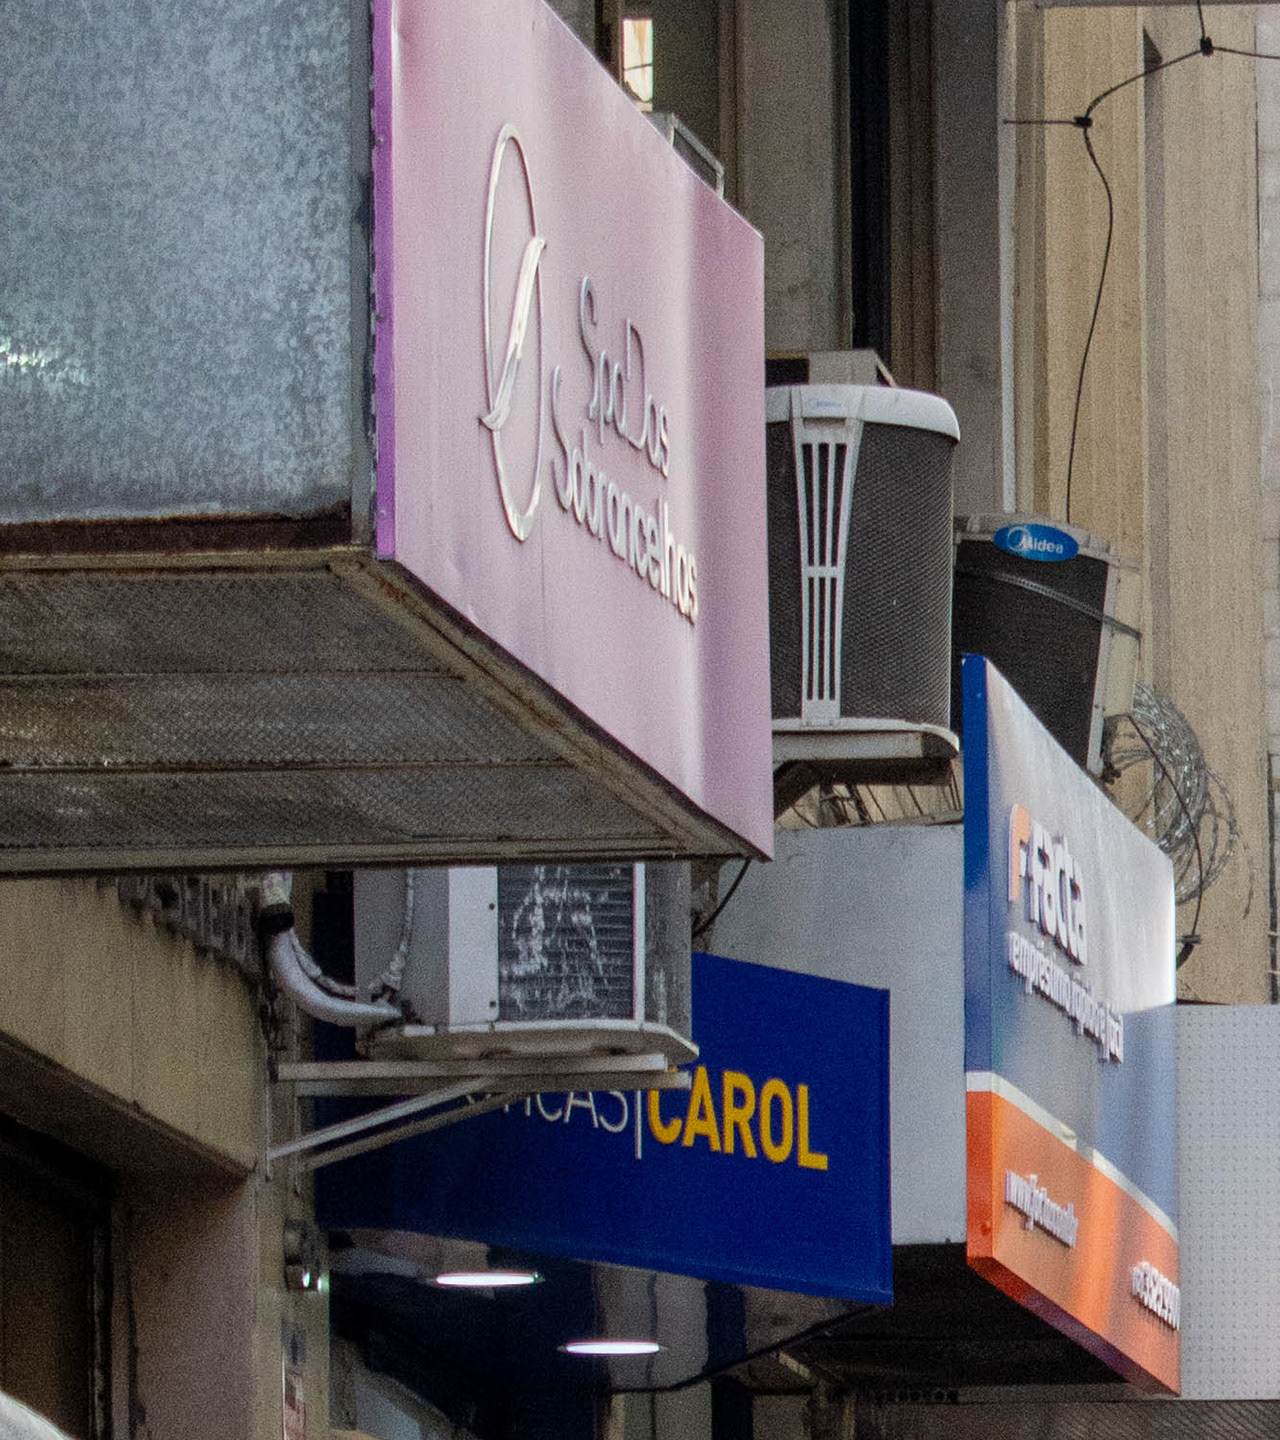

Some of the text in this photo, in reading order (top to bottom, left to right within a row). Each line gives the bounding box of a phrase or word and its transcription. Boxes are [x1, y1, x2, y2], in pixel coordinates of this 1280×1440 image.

[551, 364, 699, 627] Sobrancelhas
[1019, 535, 1064, 555] Midea
[1027, 821, 1089, 966] facta
[647, 1064, 829, 1171] CAROL
